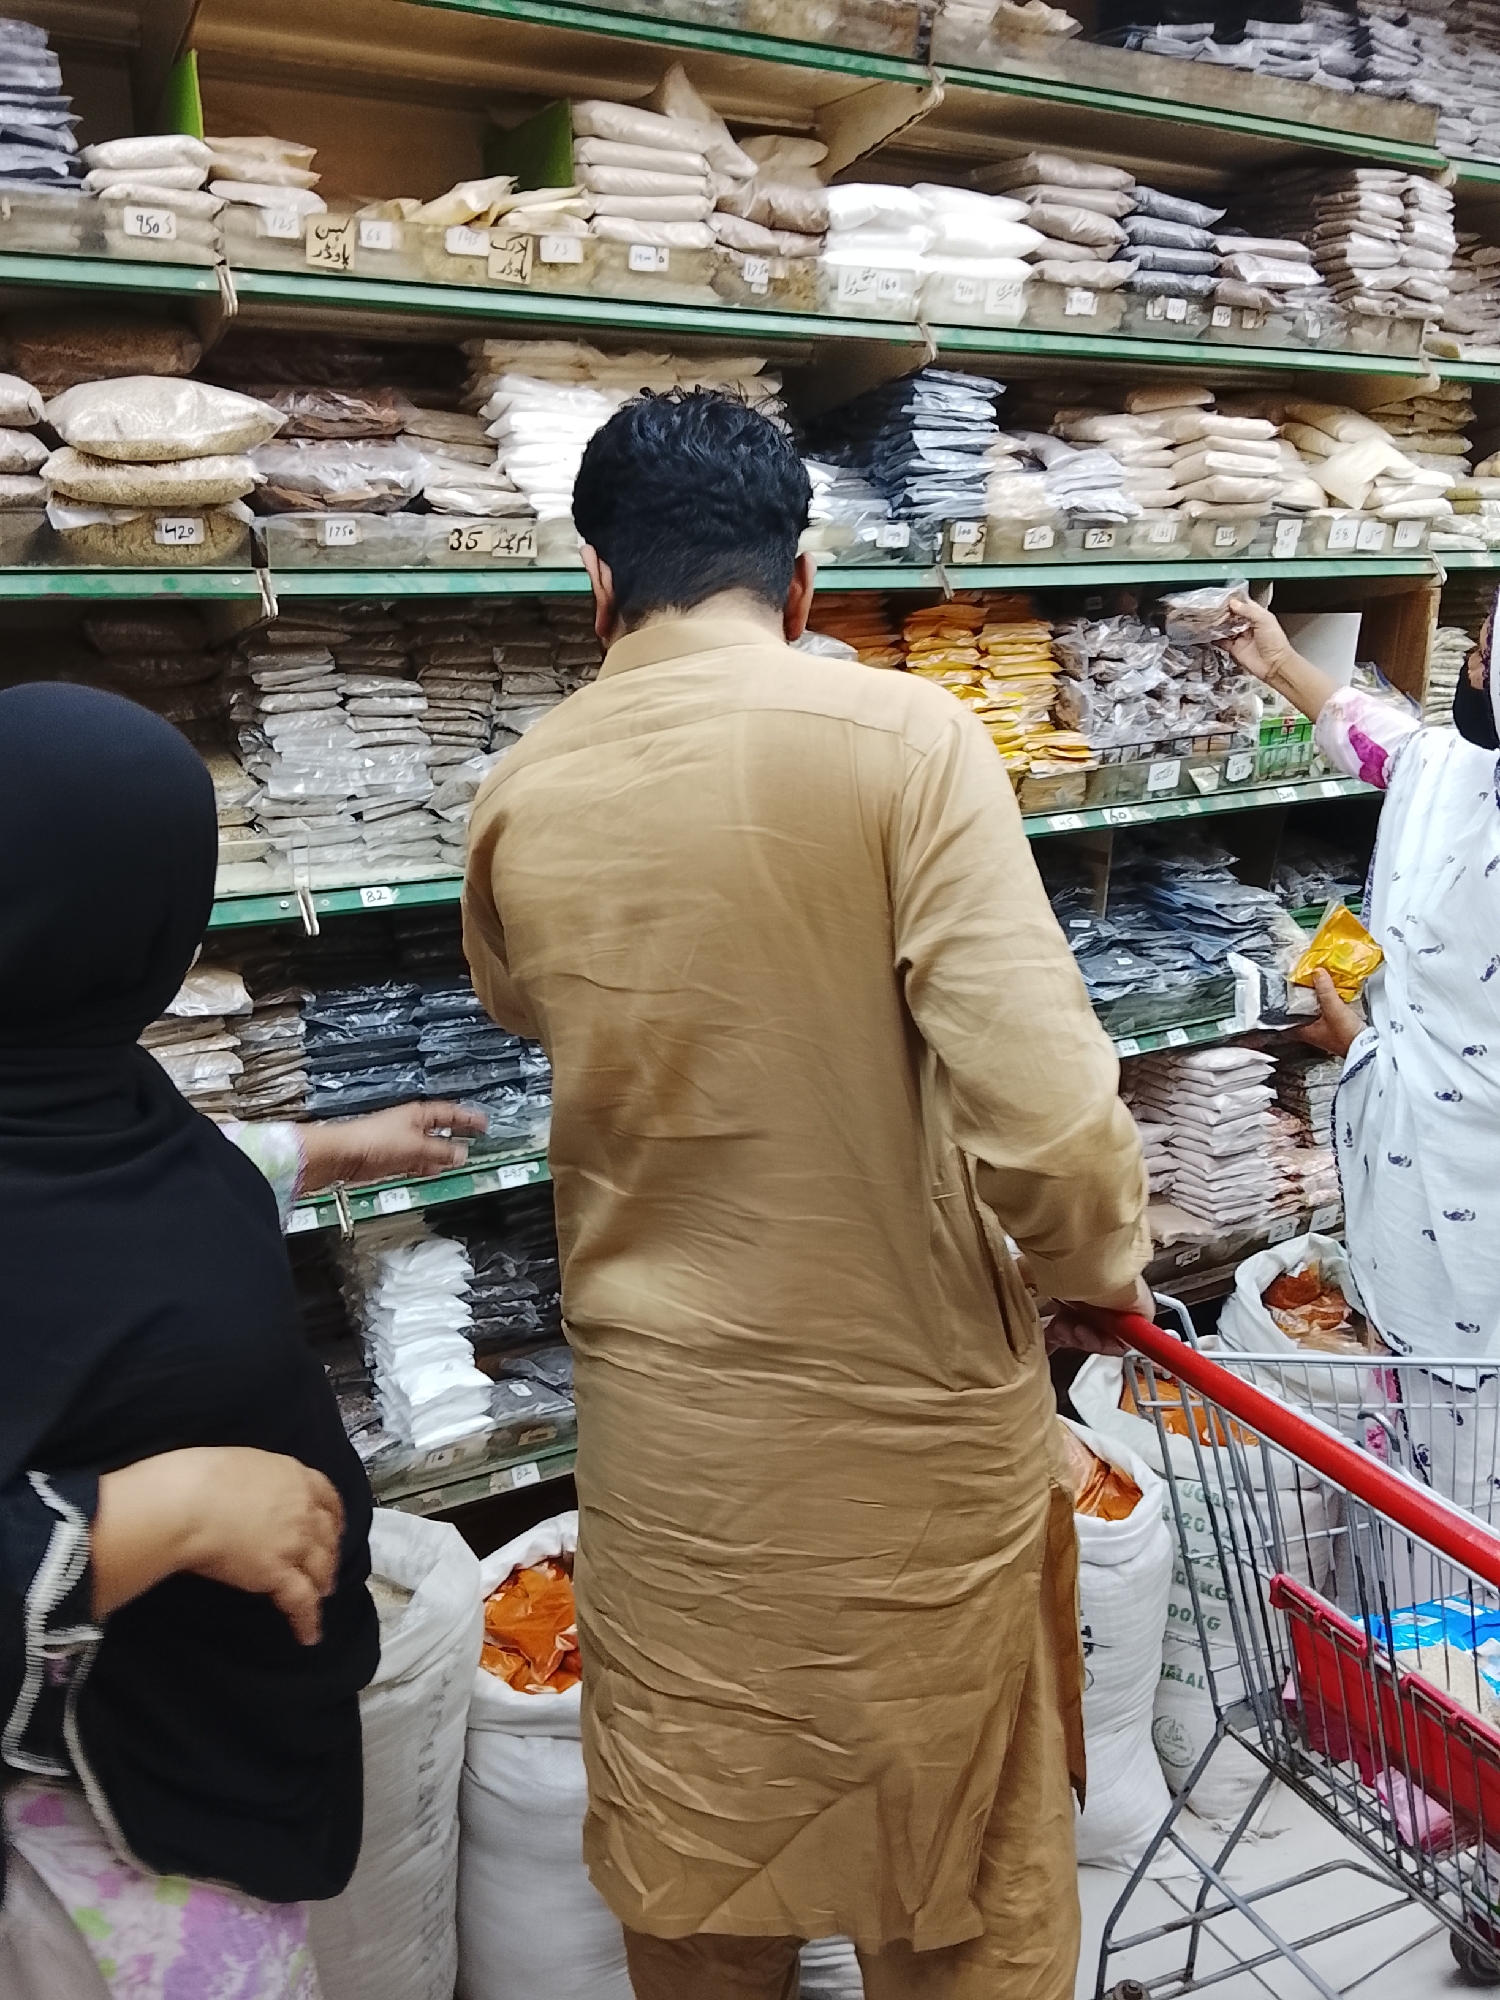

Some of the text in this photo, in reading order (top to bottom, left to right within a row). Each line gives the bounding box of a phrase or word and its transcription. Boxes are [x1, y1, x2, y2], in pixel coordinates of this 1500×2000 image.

[135, 214, 160, 235] 950
[164, 525, 195, 541] 420
[449, 527, 483, 551] 35
[1108, 809, 1128, 824] 60
[365, 889, 388, 903] 82
[1274, 1222, 1295, 1238] 23
